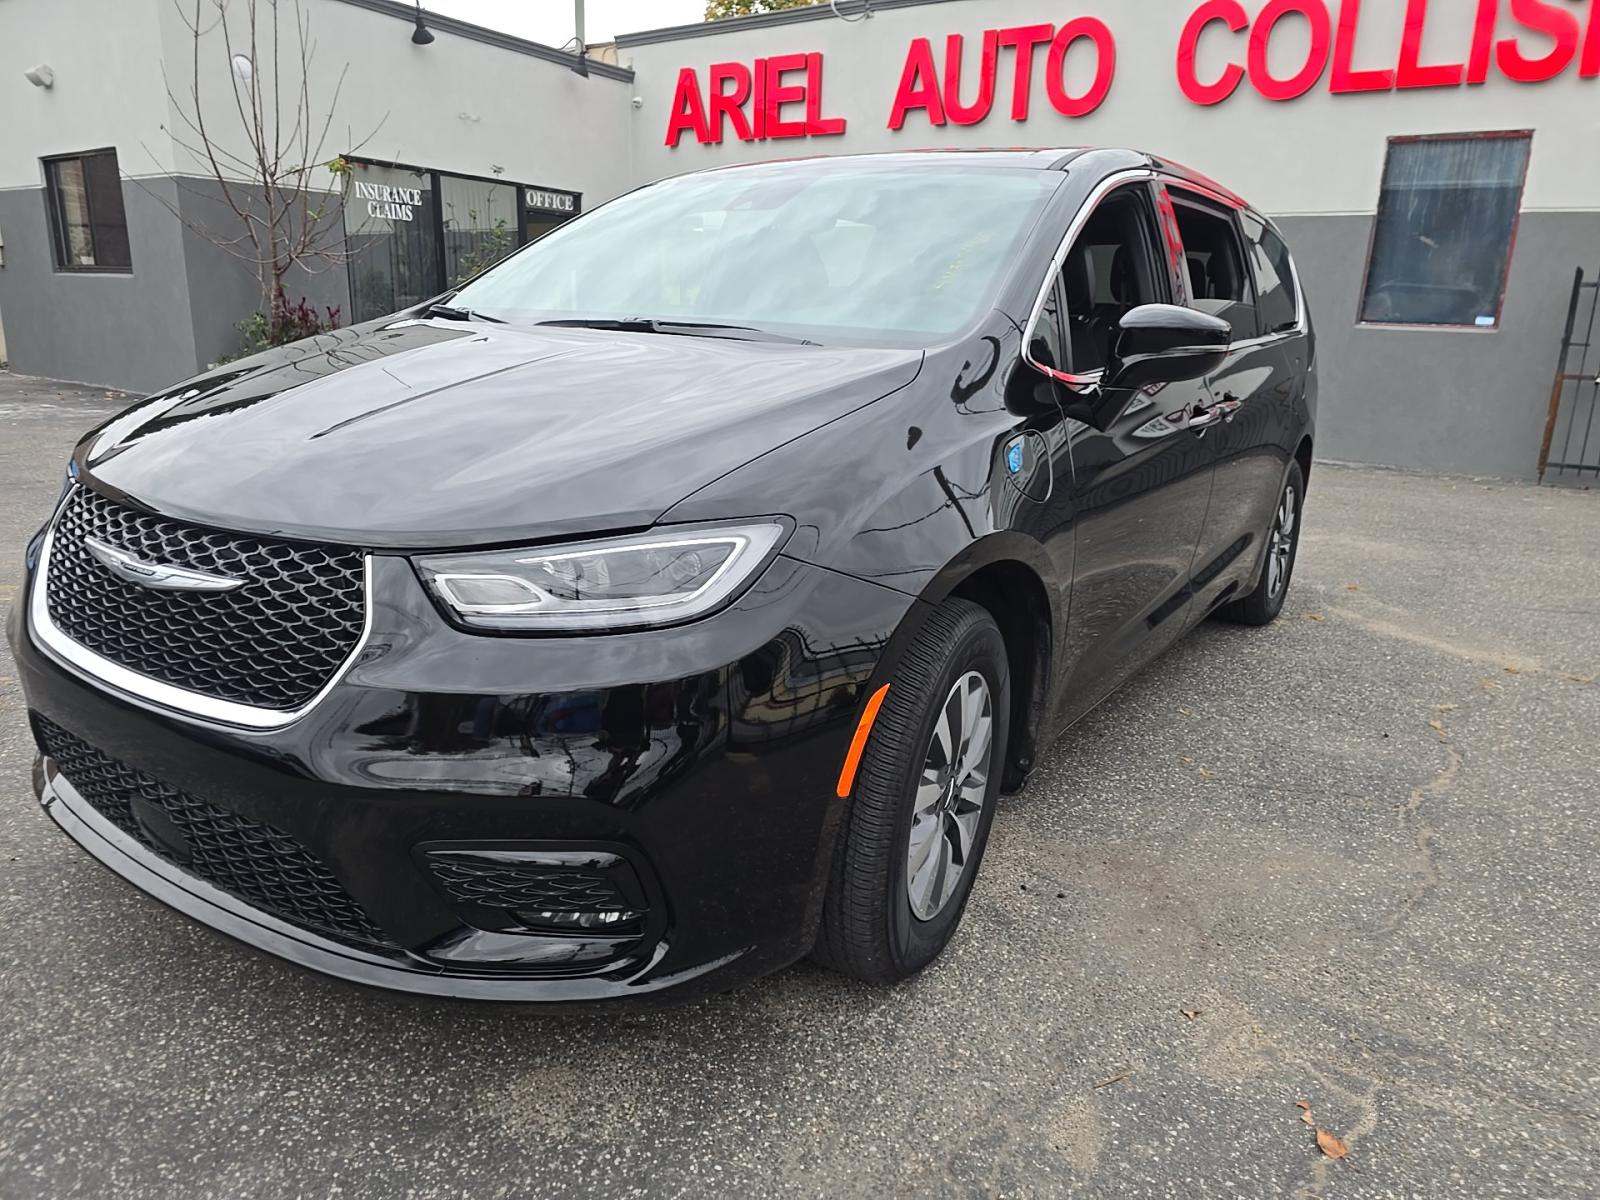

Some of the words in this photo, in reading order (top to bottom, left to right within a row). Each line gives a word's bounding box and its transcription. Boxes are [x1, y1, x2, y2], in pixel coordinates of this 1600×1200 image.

[665, 52, 846, 147] ARIEL
[887, 15, 1116, 129] AUTO
[354, 181, 422, 206] INSURANCE
[525, 190, 574, 211] OFFICE
[367, 200, 413, 222] CLAIMS
